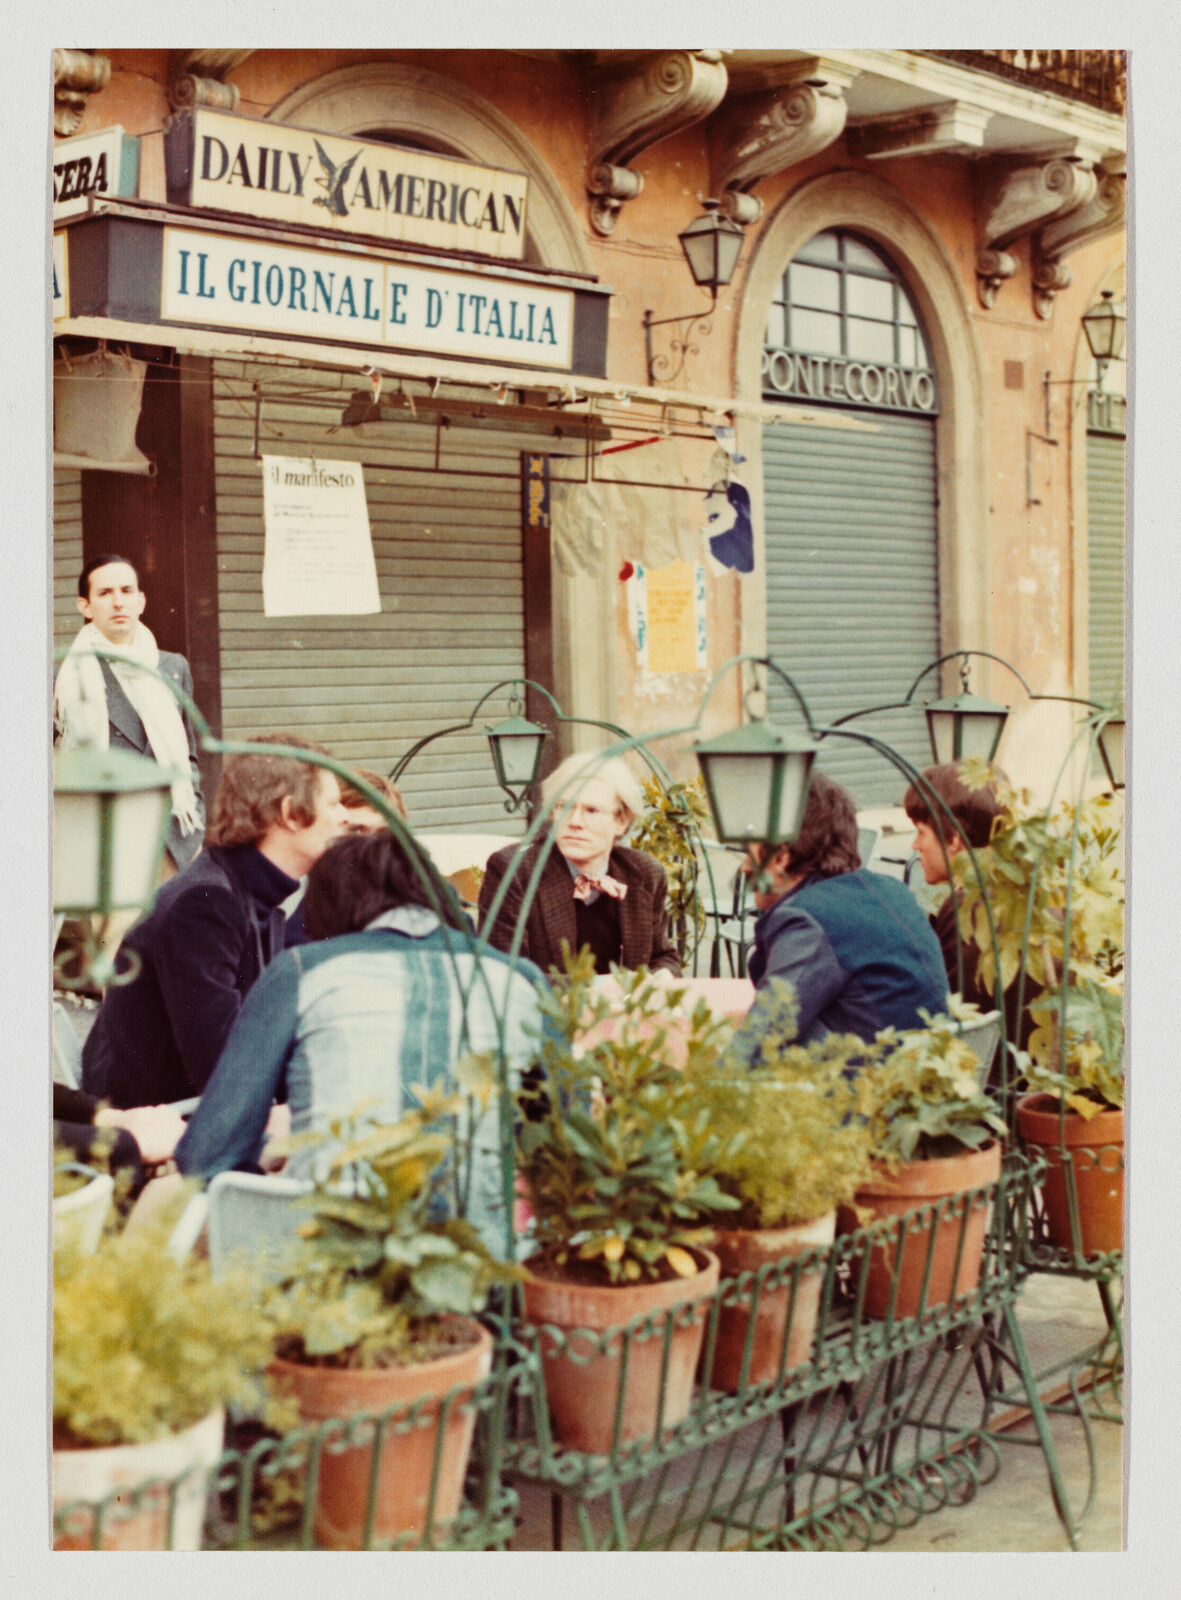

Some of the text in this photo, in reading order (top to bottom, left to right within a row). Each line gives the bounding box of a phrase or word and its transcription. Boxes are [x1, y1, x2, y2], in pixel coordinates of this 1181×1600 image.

[200, 135, 524, 236] DAILY AMERICAN
[178, 250, 215, 298] IL
[228, 259, 408, 325] GIORNALE
